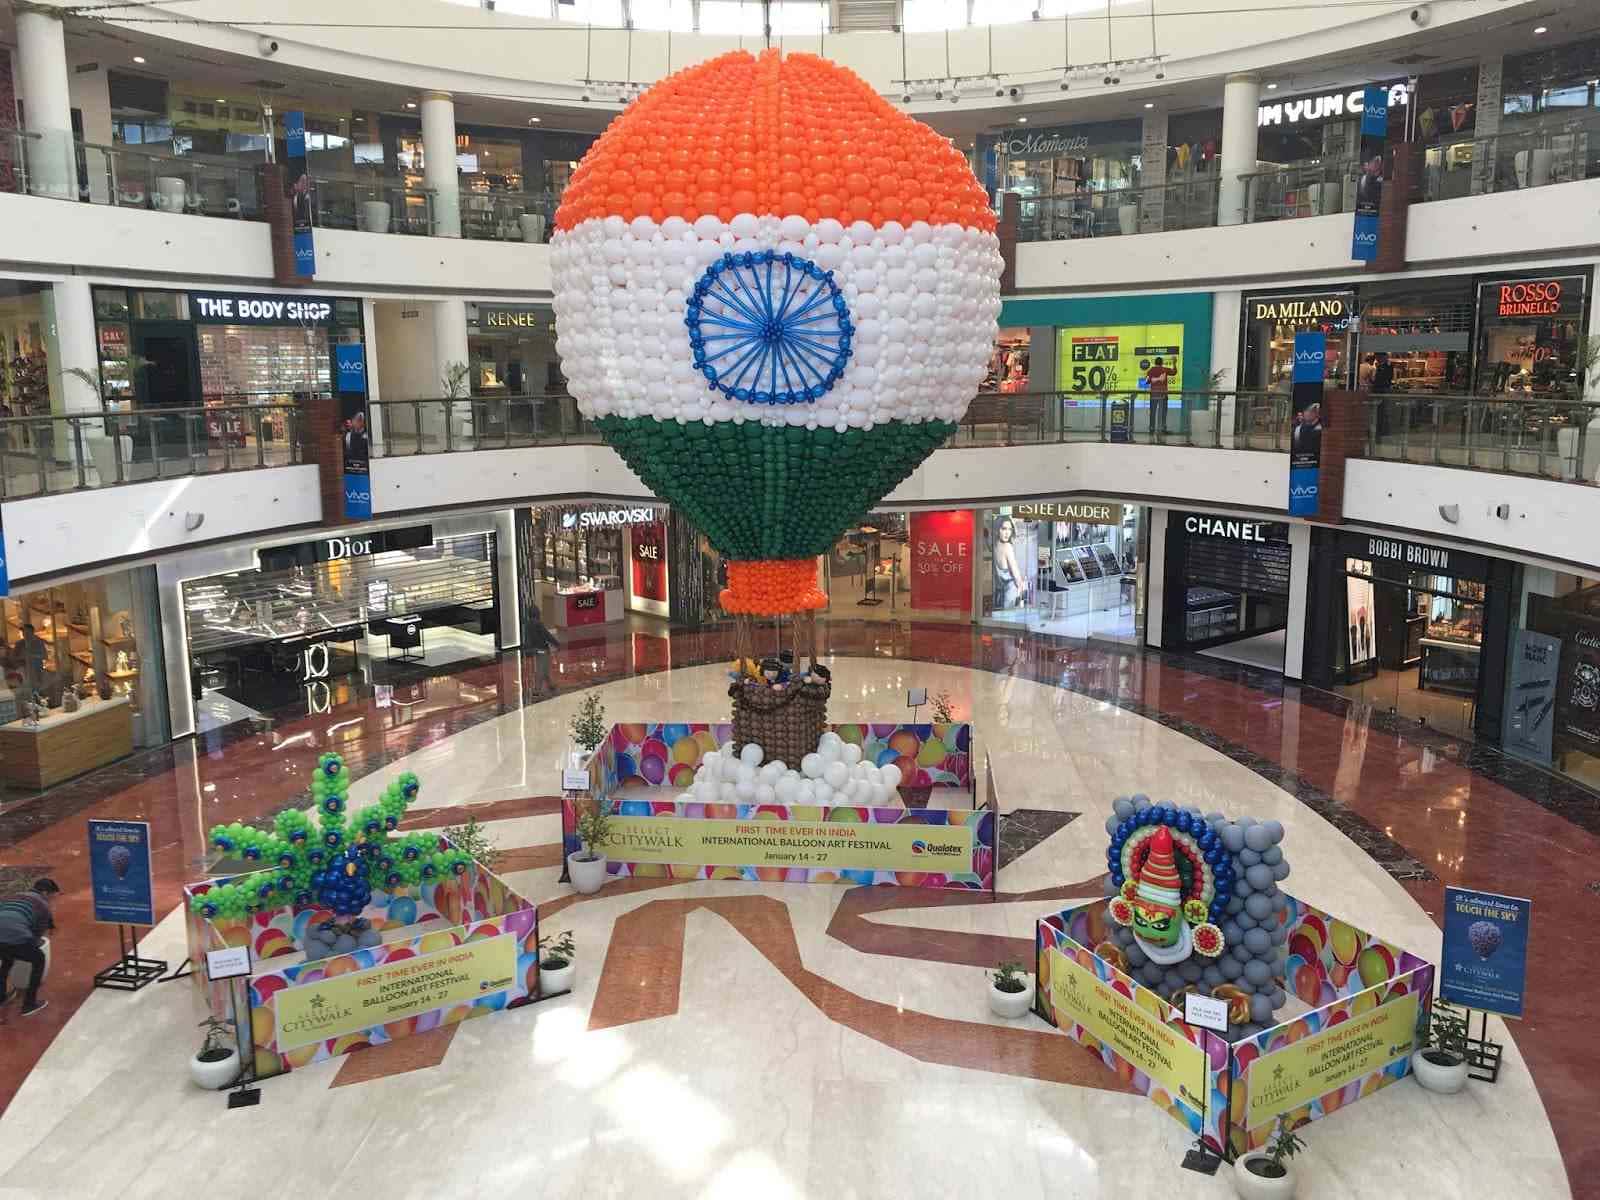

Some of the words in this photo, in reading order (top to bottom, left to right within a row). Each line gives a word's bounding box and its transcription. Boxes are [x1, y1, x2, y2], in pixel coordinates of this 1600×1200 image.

[1285, 94, 1344, 122] YUM
[1346, 84, 1409, 113] CA
[1364, 105, 1387, 116] vivo
[1010, 134, 1088, 154] Moments
[1355, 231, 1377, 241] vivo
[1500, 282, 1560, 304] ROSSO
[197, 298, 234, 318] THE
[238, 301, 284, 319] BODY
[287, 303, 331, 319] SHOP
[1256, 303, 1278, 319] DA
[1279, 300, 1342, 318] MILANO
[1499, 301, 1560, 316] BRUNELLO
[487, 311, 536, 327] RENEE
[1074, 344, 1117, 361] FLAT
[1296, 350, 1324, 360] vivo
[338, 360, 364, 370] vivo
[1071, 365, 1118, 392] 50%
[345, 489, 370, 500] vivo
[1291, 486, 1318, 495] vivo
[580, 508, 654, 526] SWAROVSKI
[1057, 503, 1110, 519] LAUDER
[1185, 517, 1265, 542] CHANEL
[326, 537, 372, 560] Dior
[640, 544, 657, 560] SALE
[917, 541, 967, 557] SALE
[1369, 538, 1402, 561] BOBBI
[1407, 544, 1449, 569] BROWN
[943, 562, 963, 574] OFF
[577, 598, 595, 608] SALE
[609, 832, 684, 848] CITYWALK
[736, 825, 760, 835] FIRST
[766, 826, 788, 836] TIME
[790, 827, 814, 836] EVER
[816, 827, 827, 836] IN
[829, 828, 857, 838] INDIA
[702, 836, 777, 847] INTERNATIONAL
[780, 837, 828, 848] BALLOON
[828, 839, 846, 849] ART
[849, 840, 893, 850] FESTIVAL
[764, 851, 796, 863] January
[799, 853, 809, 862] 14
[816, 853, 828, 862] 27
[1456, 904, 1482, 915] TOUCH
[1502, 911, 1519, 921] SKY
[356, 974, 383, 988] FIRST
[386, 969, 409, 981] TIME
[411, 962, 434, 976] EVER
[436, 957, 448, 967] IN
[448, 951, 475, 964] INDIA
[379, 968, 455, 993] INTERNATIONAL
[362, 989, 409, 1008] BALLOON
[409, 984, 428, 998] ART
[430, 974, 472, 990] FESTIVAL
[1095, 985, 1111, 1001] FIRST
[1113, 998, 1128, 1013] TIME
[1130, 1008, 1146, 1025] EVER
[1158, 1025, 1176, 1049] INDIA
[1109, 1008, 1161, 1051] INTERNATIONAL
[1305, 1040, 1324, 1056] FIRST
[1327, 1033, 1342, 1046] TIME
[1344, 1025, 1361, 1039] EVER
[1370, 1012, 1390, 1028] INDIA
[1098, 1010, 1126, 1038] BALLOON
[1127, 1031, 1141, 1046] ART
[1142, 1041, 1173, 1071] FESTIVAL
[1321, 1033, 1373, 1061] INTERNATIONAL
[1308, 1055, 1343, 1078] BALLOON
[1343, 1051, 1355, 1065] ART
[1355, 1039, 1384, 1058] FESTIVAL
